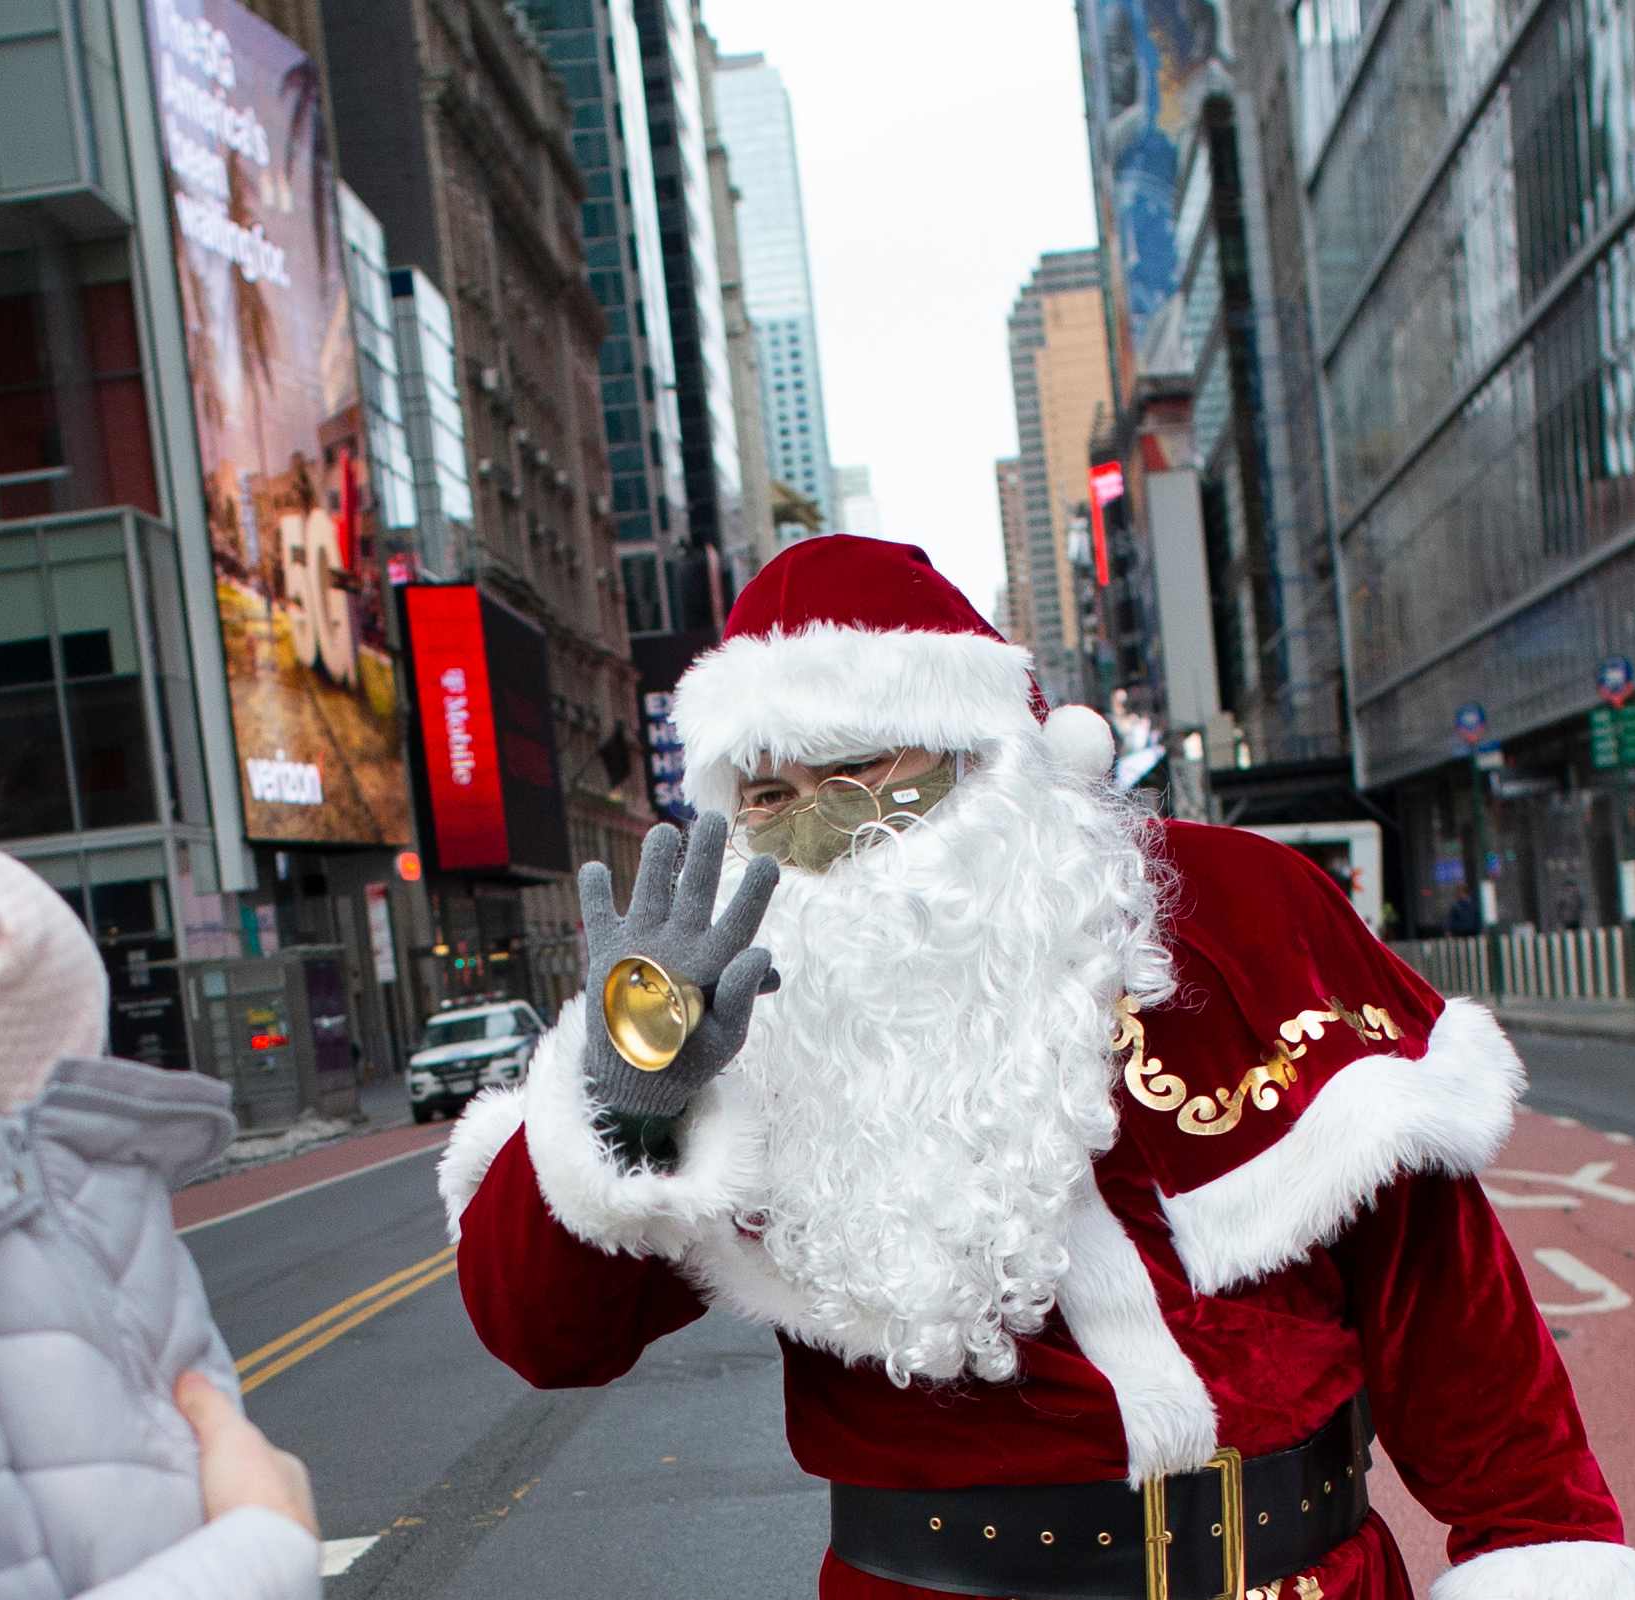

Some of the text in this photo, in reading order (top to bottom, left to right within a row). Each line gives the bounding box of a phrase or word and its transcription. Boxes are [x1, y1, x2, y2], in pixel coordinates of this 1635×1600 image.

[160, 50, 270, 168] America's
[245, 749, 324, 806] verizon
[443, 695, 476, 786] Mobile
